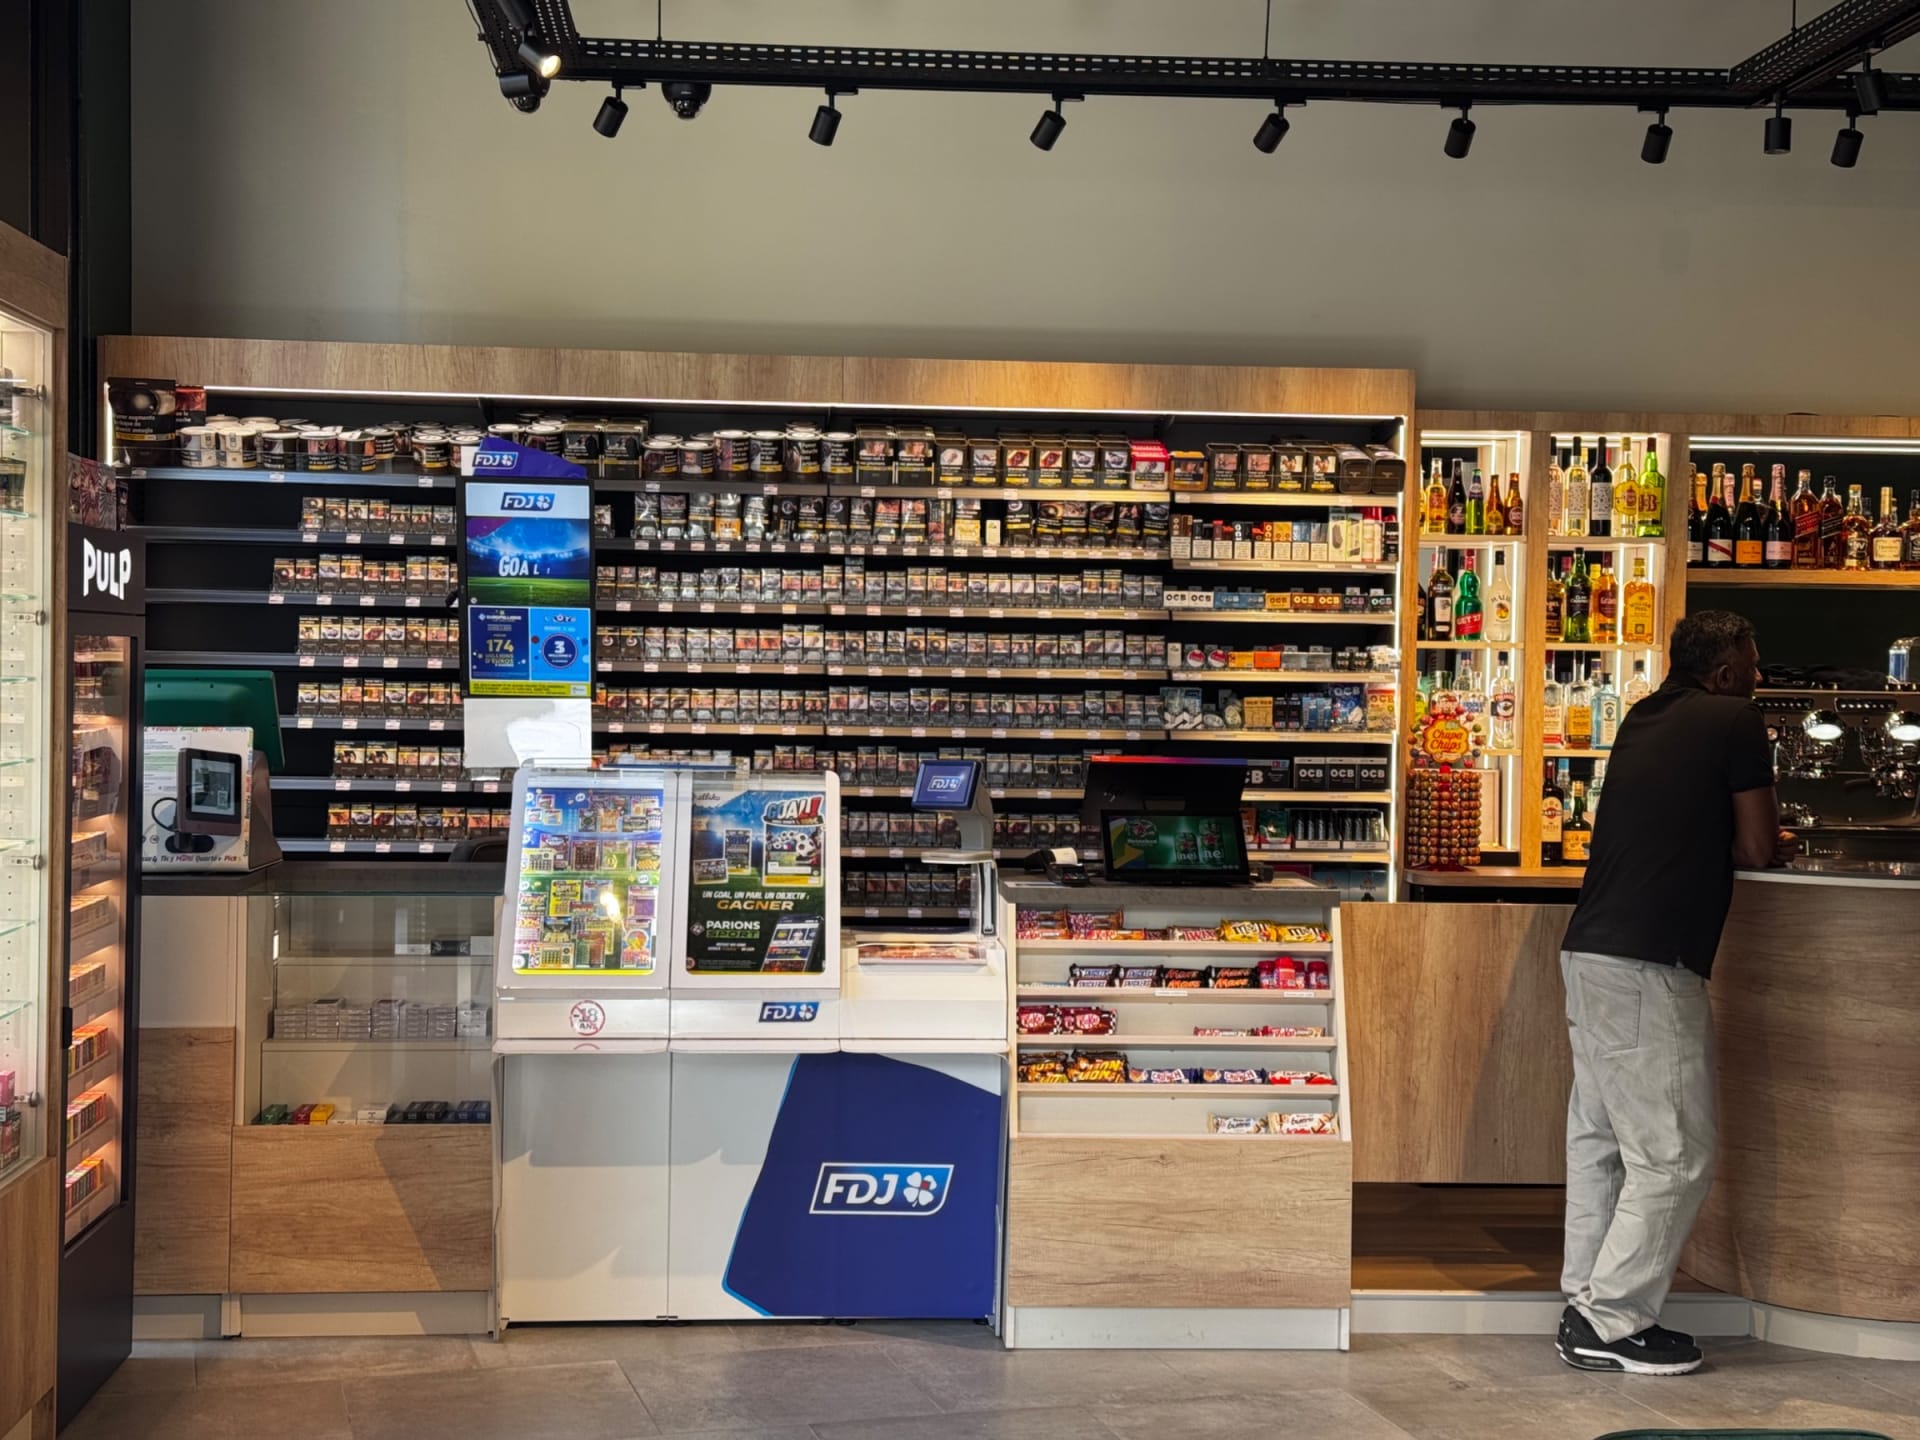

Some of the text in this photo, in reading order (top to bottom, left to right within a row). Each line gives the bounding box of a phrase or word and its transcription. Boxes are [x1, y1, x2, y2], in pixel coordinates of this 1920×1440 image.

[475, 454, 500, 466] FDJ
[504, 496, 535, 508] FDJ
[83, 537, 132, 601] PULP
[1166, 594, 1186, 602] OCB
[1191, 594, 1212, 602] OCB
[1270, 596, 1288, 604] OCB
[1294, 596, 1314, 604] OCB
[1319, 596, 1340, 604] OCB
[1344, 597, 1365, 605] OCB
[1372, 597, 1392, 606] OCB
[486, 640, 514, 652] 174
[554, 640, 566, 654] 3
[1334, 686, 1360, 696] OCB
[1432, 730, 1463, 740] Chupa
[1430, 740, 1461, 750] Chups
[1298, 768, 1324, 778] OCB
[1330, 768, 1354, 778] OCB
[1361, 769, 1385, 778] OCB
[930, 778, 949, 789] FDJ
[702, 890, 712, 899] UN
[734, 891, 744, 899] UN
[764, 892, 774, 900] UN
[716, 900, 794, 911] GAGNER
[706, 920, 760, 930] PARIONS
[706, 930, 760, 938] SPORT
[762, 1005, 796, 1020] FDJ
[1291, 1117, 1315, 1126] bueno
[822, 1173, 900, 1206] FDJ
